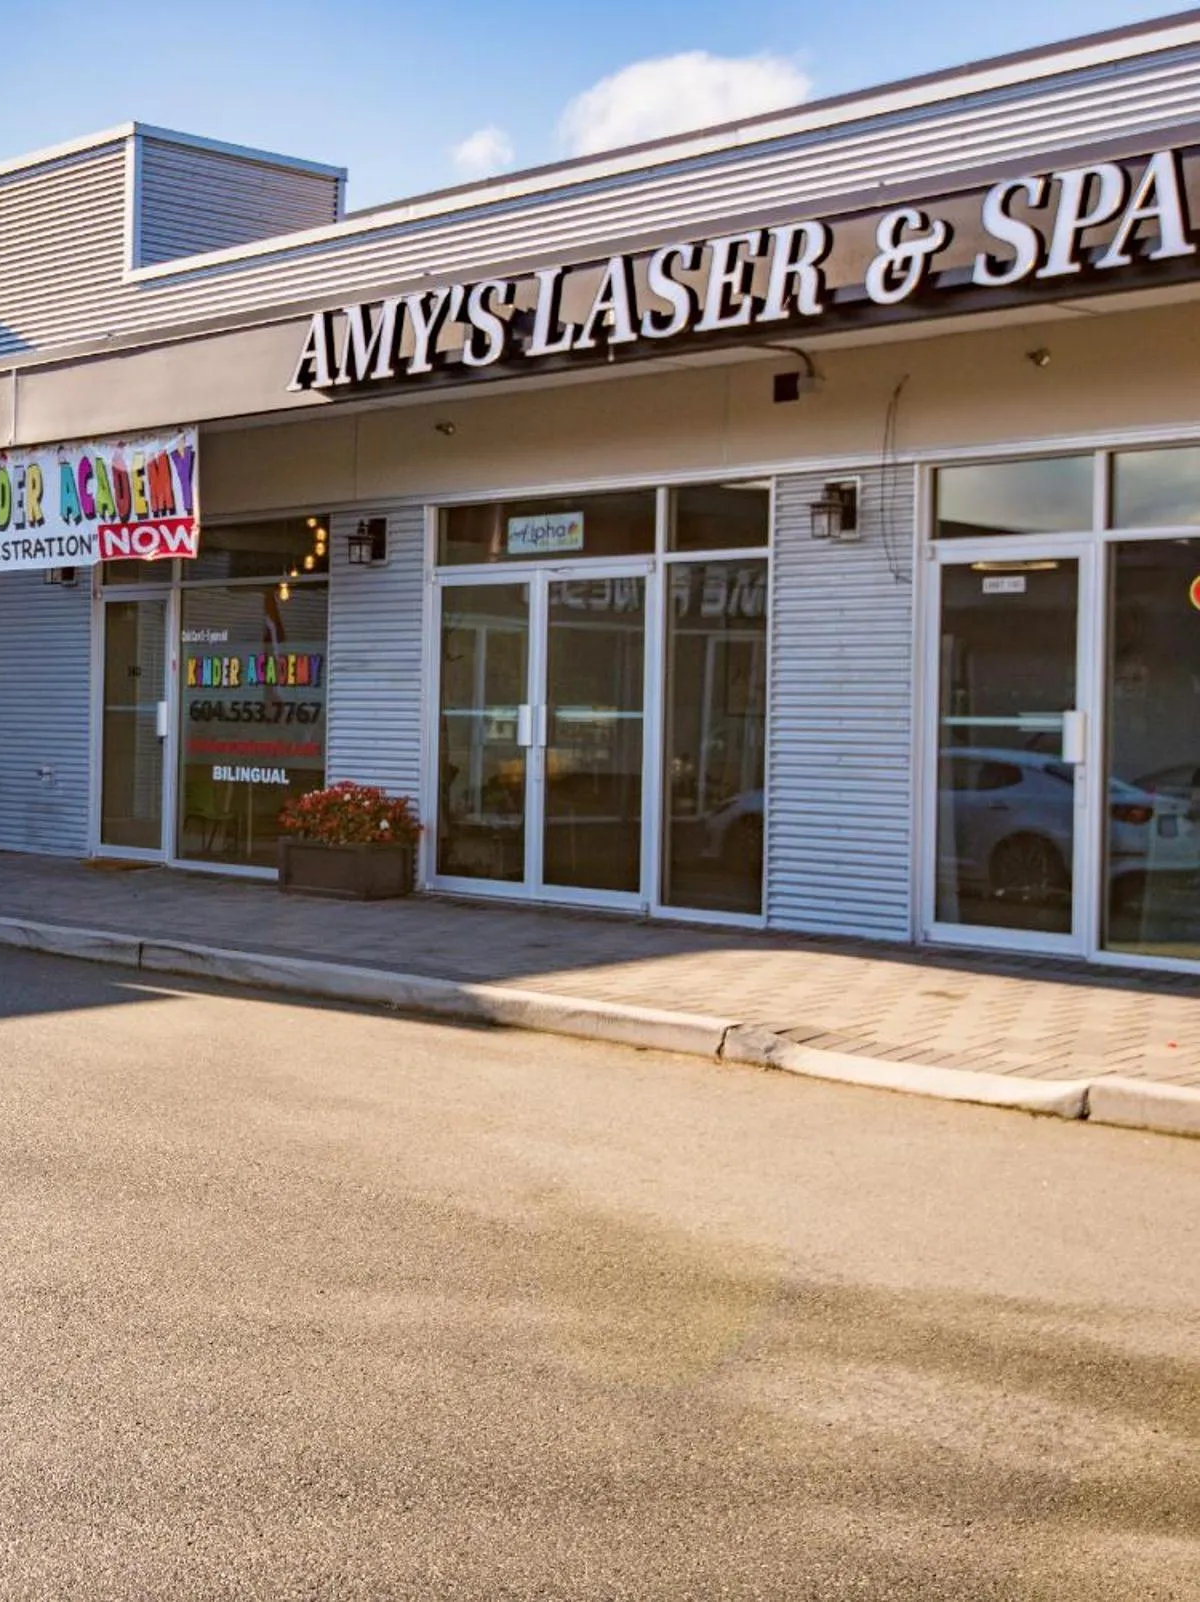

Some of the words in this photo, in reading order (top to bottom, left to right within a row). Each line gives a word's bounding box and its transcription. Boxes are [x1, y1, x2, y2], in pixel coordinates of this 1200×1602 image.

[286, 280, 506, 391] AMY'S
[525, 220, 824, 357] LASER
[865, 207, 946, 305] &
[972, 148, 1197, 287] SPA
[59, 446, 196, 525] ACADEMY
[103, 524, 197, 556] NOW
[247, 653, 323, 688] ACADEMY
[189, 700, 323, 725] 604.553.7767
[211, 764, 291, 786] BILINGUAL
